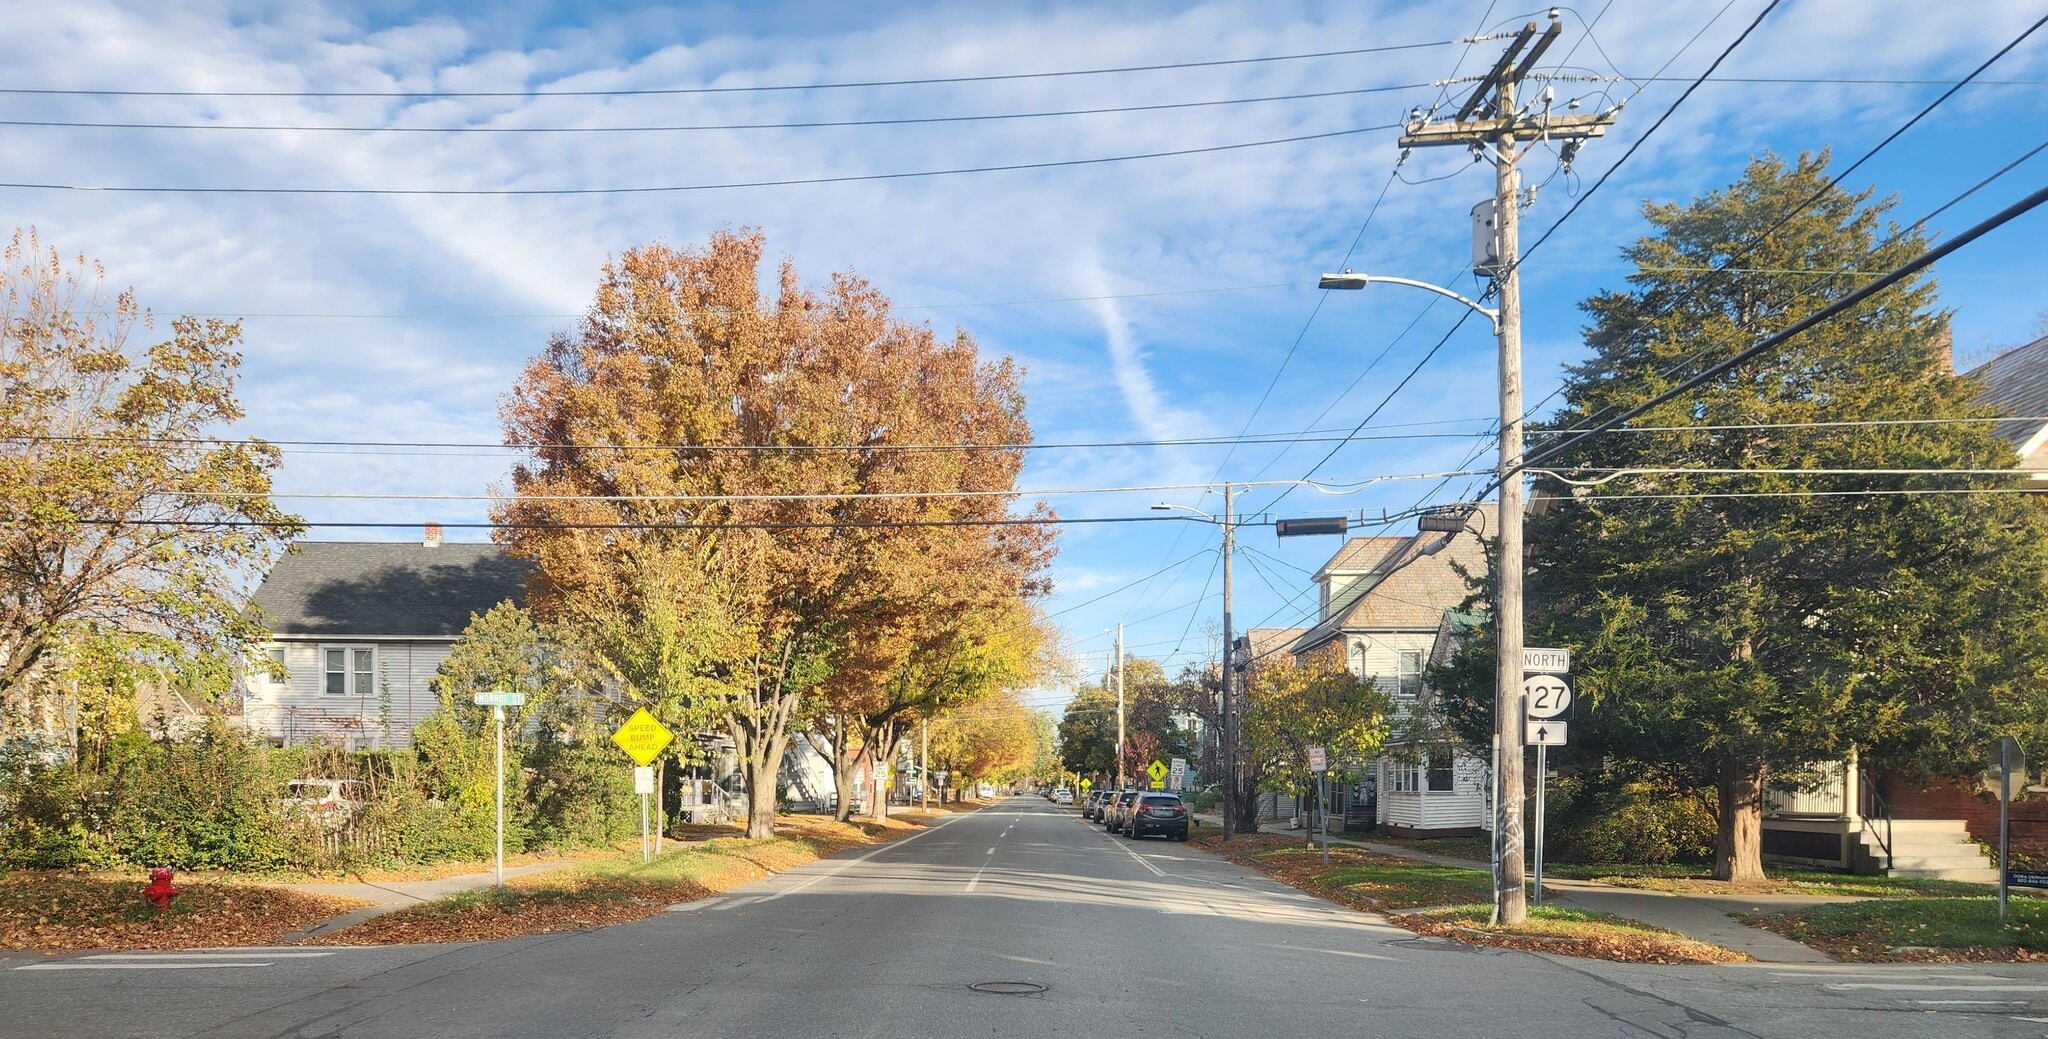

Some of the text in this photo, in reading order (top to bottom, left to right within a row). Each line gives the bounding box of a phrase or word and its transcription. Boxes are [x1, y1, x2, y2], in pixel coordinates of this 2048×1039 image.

[1524, 653, 1566, 667] NORTH
[478, 694, 522, 704] MONROE ST
[628, 724, 657, 732] SPEED
[628, 743, 658, 751] AHEAD
[875, 770, 886, 778] 25
[1172, 767, 1184, 775] 25
